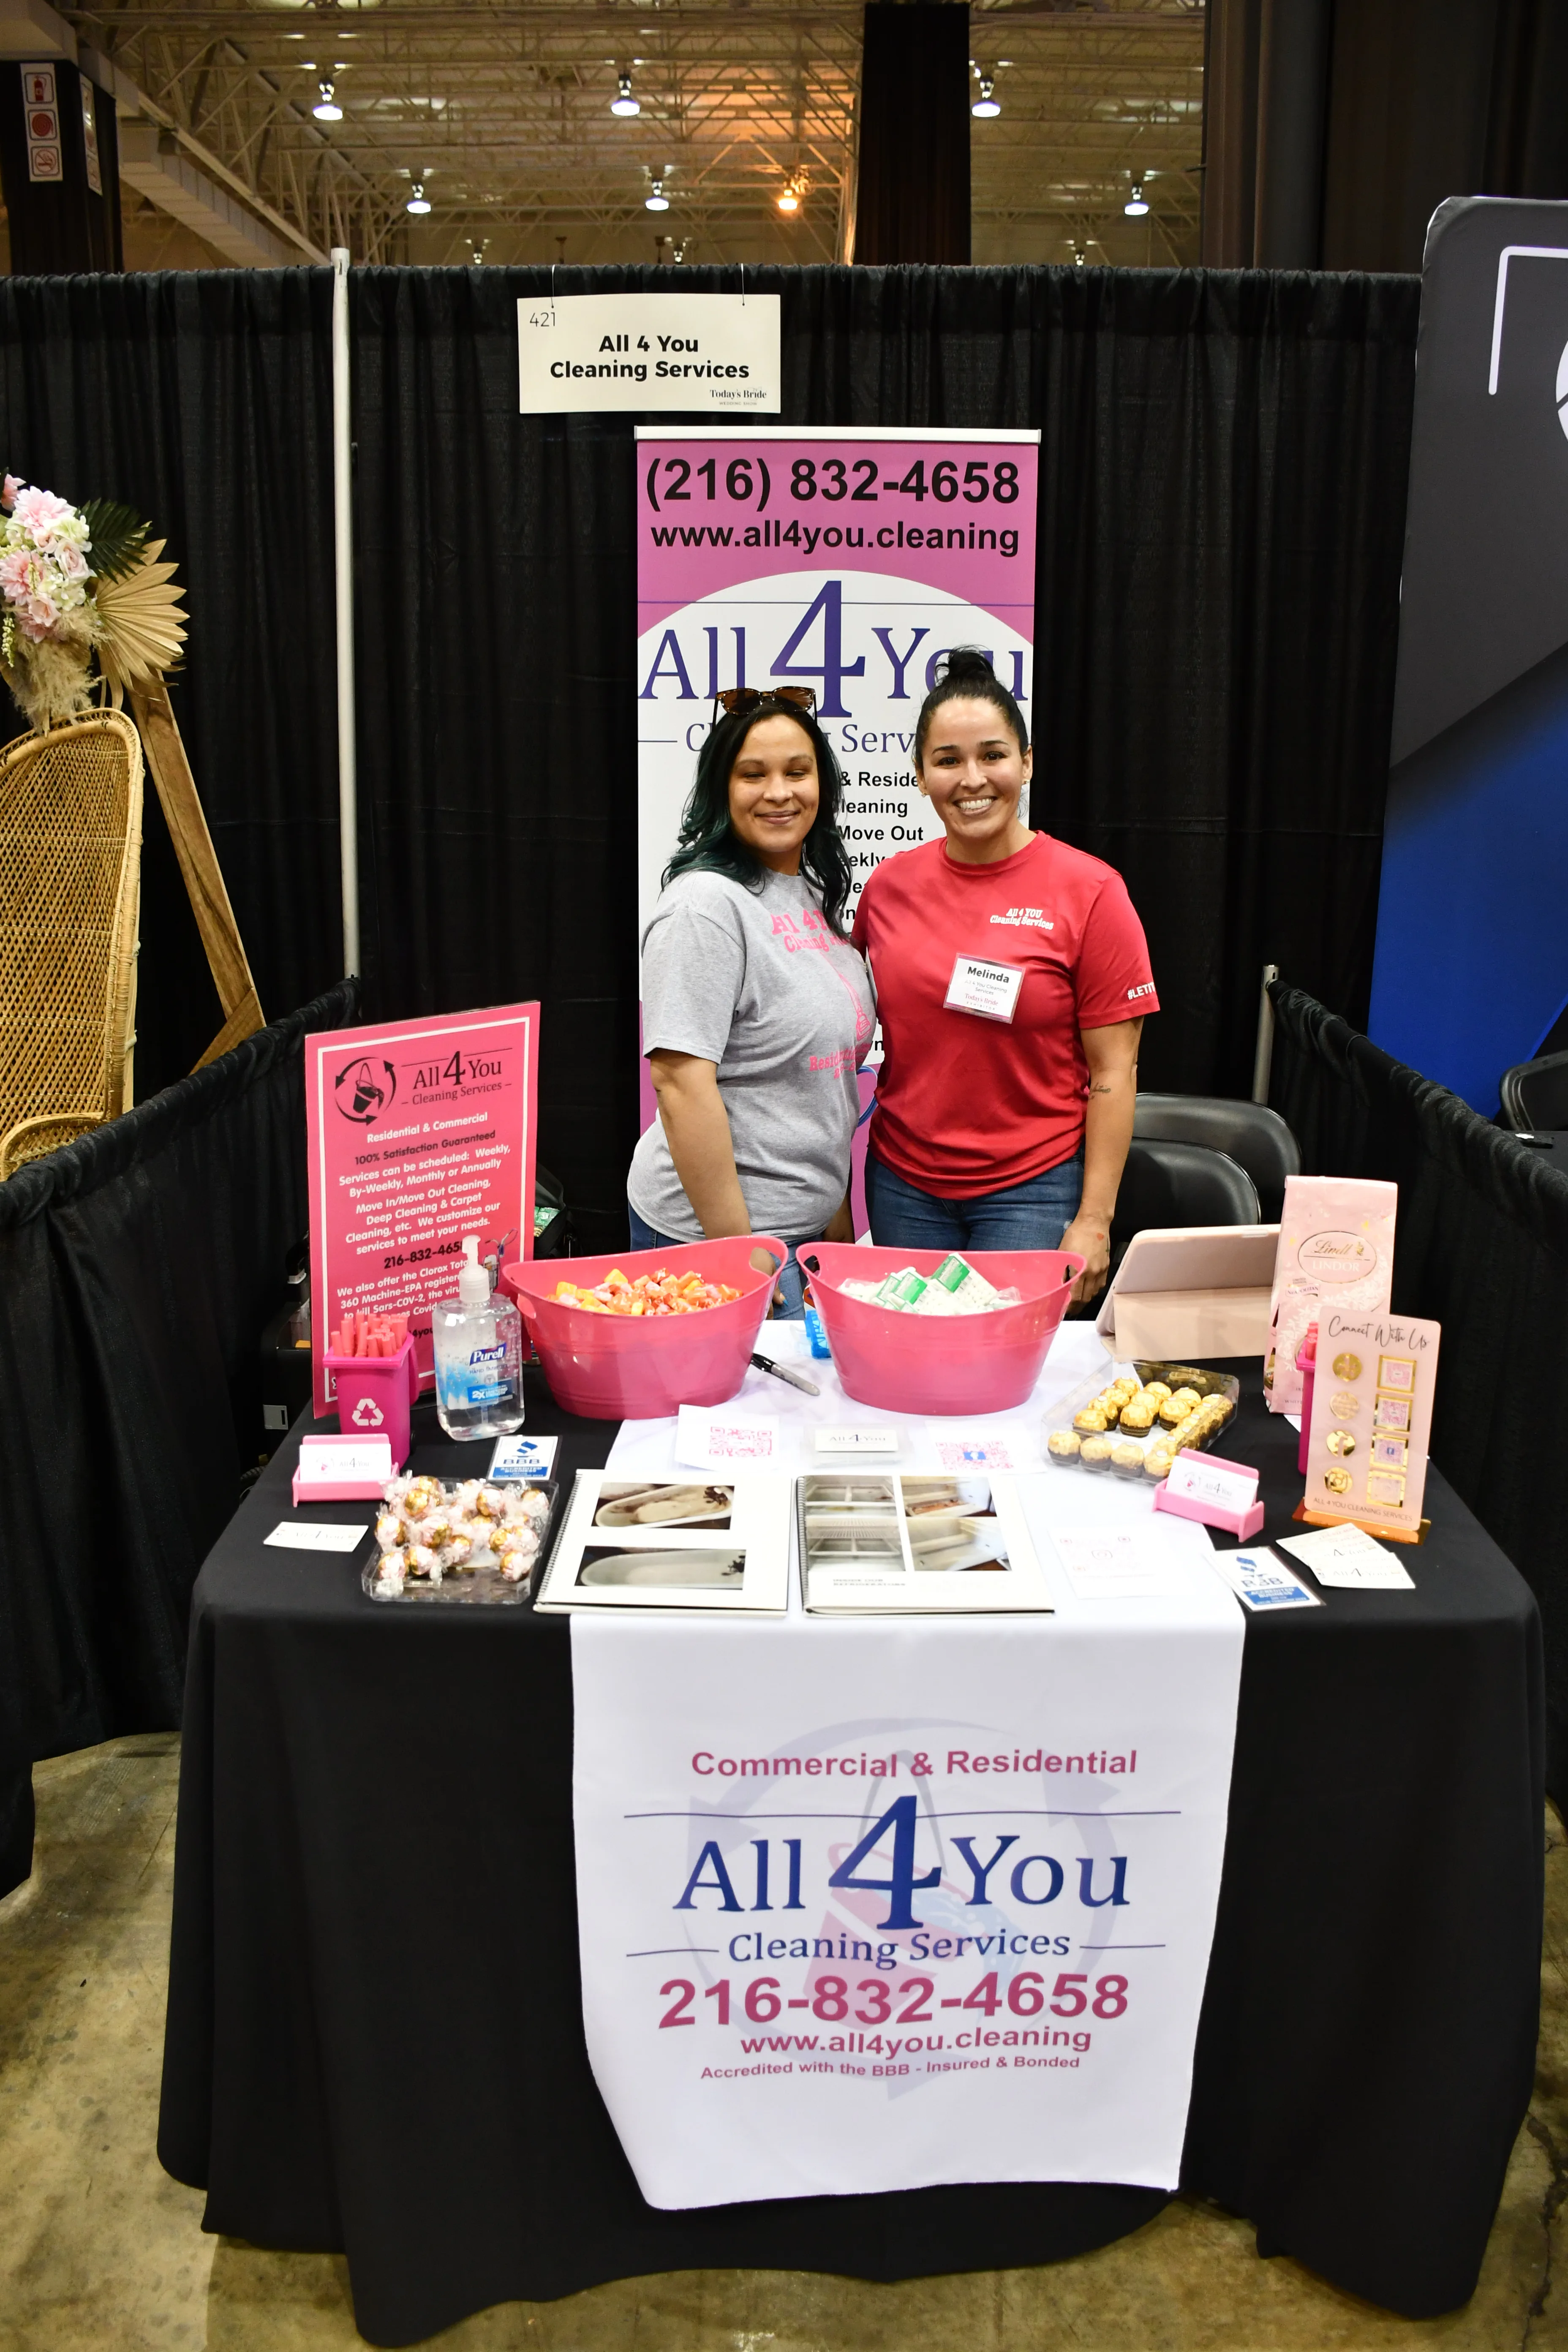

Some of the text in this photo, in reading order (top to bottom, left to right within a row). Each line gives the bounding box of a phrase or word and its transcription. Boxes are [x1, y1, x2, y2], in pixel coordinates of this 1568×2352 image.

[529, 312, 556, 327] 421
[599, 335, 699, 352] All 4 You
[550, 359, 750, 382] Cleaning Services
[709, 389, 767, 400] Today's Bride
[646, 457, 1020, 512] (216) 832-4658
[651, 519, 1019, 558] www.all4you.cleaning
[638, 626, 746, 700] All
[769, 580, 866, 718] 4
[841, 724, 917, 753] Serv
[858, 771, 918, 787] Reside
[841, 799, 908, 818] leaning
[891, 826, 924, 841] Out
[803, 909, 818, 931] 4
[990, 915, 1054, 930] Cleaning Services
[1006, 908, 1043, 918] All 4 YOU
[967, 966, 1010, 983] Melinda
[975, 987, 994, 995] Services
[984, 998, 999, 1006] Bride
[986, 984, 1007, 994] Cleaning
[413, 1051, 502, 1090] All 4 You
[413, 1082, 502, 1105] Cleaning Services
[367, 1112, 488, 1143] Residential & Commercial
[355, 1130, 496, 1165] 100% Satisfaction Guaranteed
[339, 1144, 511, 1187] Services can be scheduled: Weekly,
[349, 1158, 502, 1199] By-Weekly, Monthly or Annually
[356, 1179, 491, 1214] Move In/Move Out Cleaning,
[366, 1192, 482, 1226] Deep Cleaning & Carpet
[346, 1202, 501, 1244] Cleaning, etc. We customize our
[357, 1217, 491, 1255] services to meet your needs.
[384, 1241, 463, 1269] 216-832-465
[1312, 1260, 1360, 1272] LINDOR
[337, 1260, 469, 1298] We also offer the Clorox Tota
[340, 1274, 460, 1309] 360 Machine-EPA registere
[373, 1293, 426, 1314] Sars-COV-2,
[428, 1290, 443, 1300] the
[445, 1286, 460, 1296] viru
[413, 1303, 437, 1315] Covid
[1328, 1316, 1429, 1351] Connect With Us
[474, 1346, 504, 1363] Purell
[349, 1457, 357, 1468] 4
[1332, 1500, 1346, 1508] YOU
[1347, 1504, 1381, 1516] CLEANING
[1383, 1511, 1413, 1522] SERVICES
[691, 1750, 1138, 1779] Commercial & Residential
[672, 1794, 1130, 1930] All 4 You
[729, 1929, 1071, 1970] Cleaning Services
[658, 1971, 1130, 2030] 216-832-4658
[740, 2026, 1092, 2060] www.all4you.cleaning
[700, 2062, 793, 2080] Accredited
[799, 2061, 834, 2074] with
[840, 2062, 866, 2076] the
[872, 2064, 910, 2077] BBB
[926, 2057, 990, 2073] Insured
[996, 2056, 1008, 2069] &
[1014, 2056, 1080, 2069] Bonded
